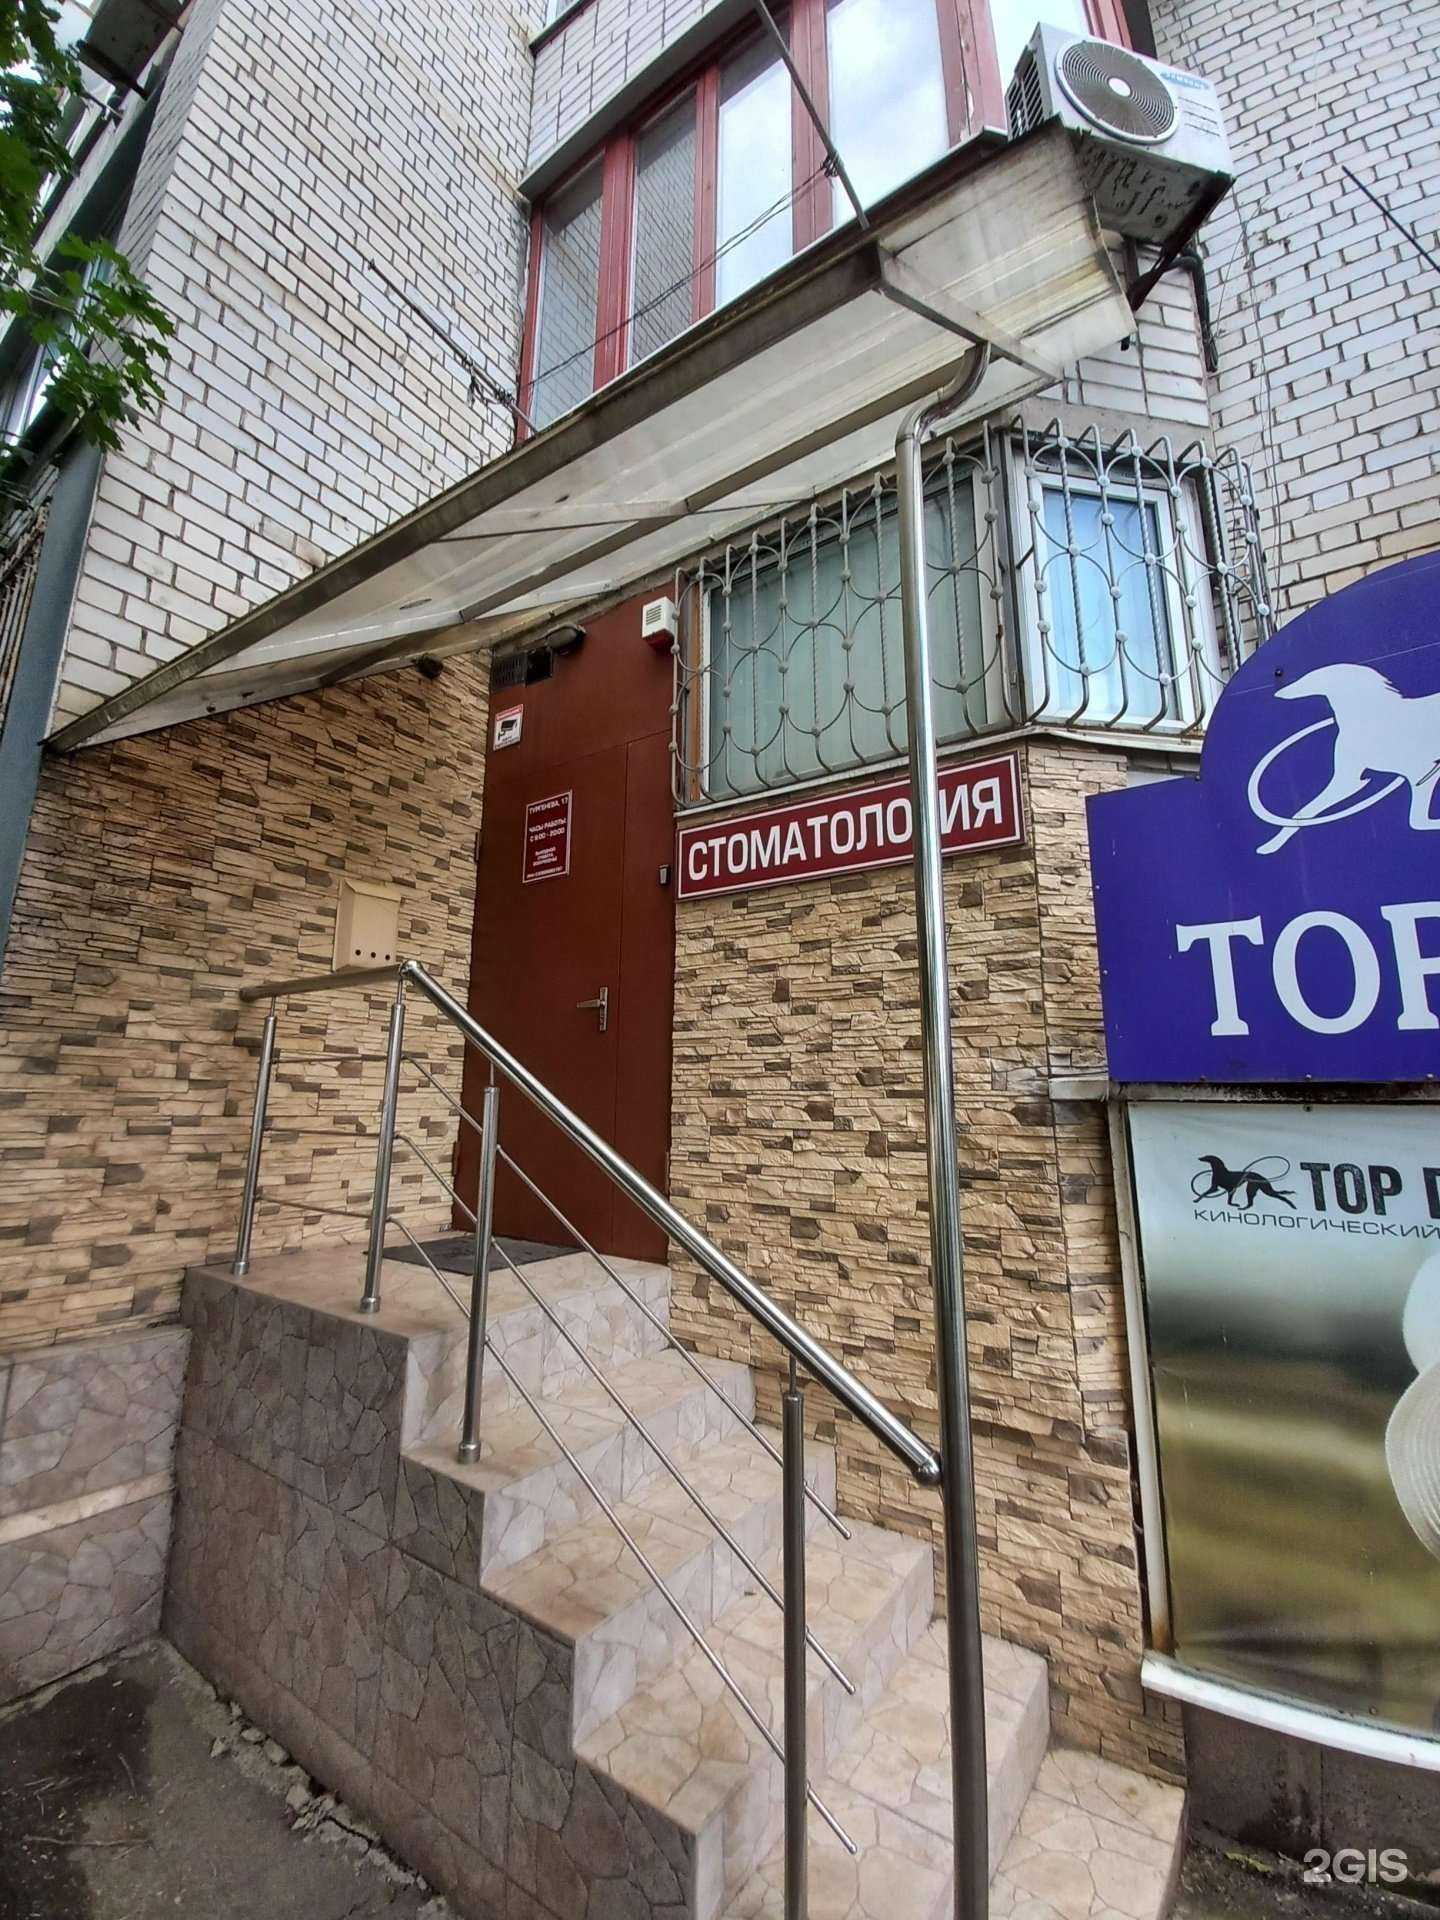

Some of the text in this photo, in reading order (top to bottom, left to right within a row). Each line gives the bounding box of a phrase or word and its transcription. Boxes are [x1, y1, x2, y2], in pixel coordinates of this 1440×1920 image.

[688, 777, 1003, 881] СТОМАТОЛОИЯ
[1300, 1162, 1403, 1216] TOP
[1194, 1208, 1440, 1239] КИНОЛОГИЧЕСКИЙ
